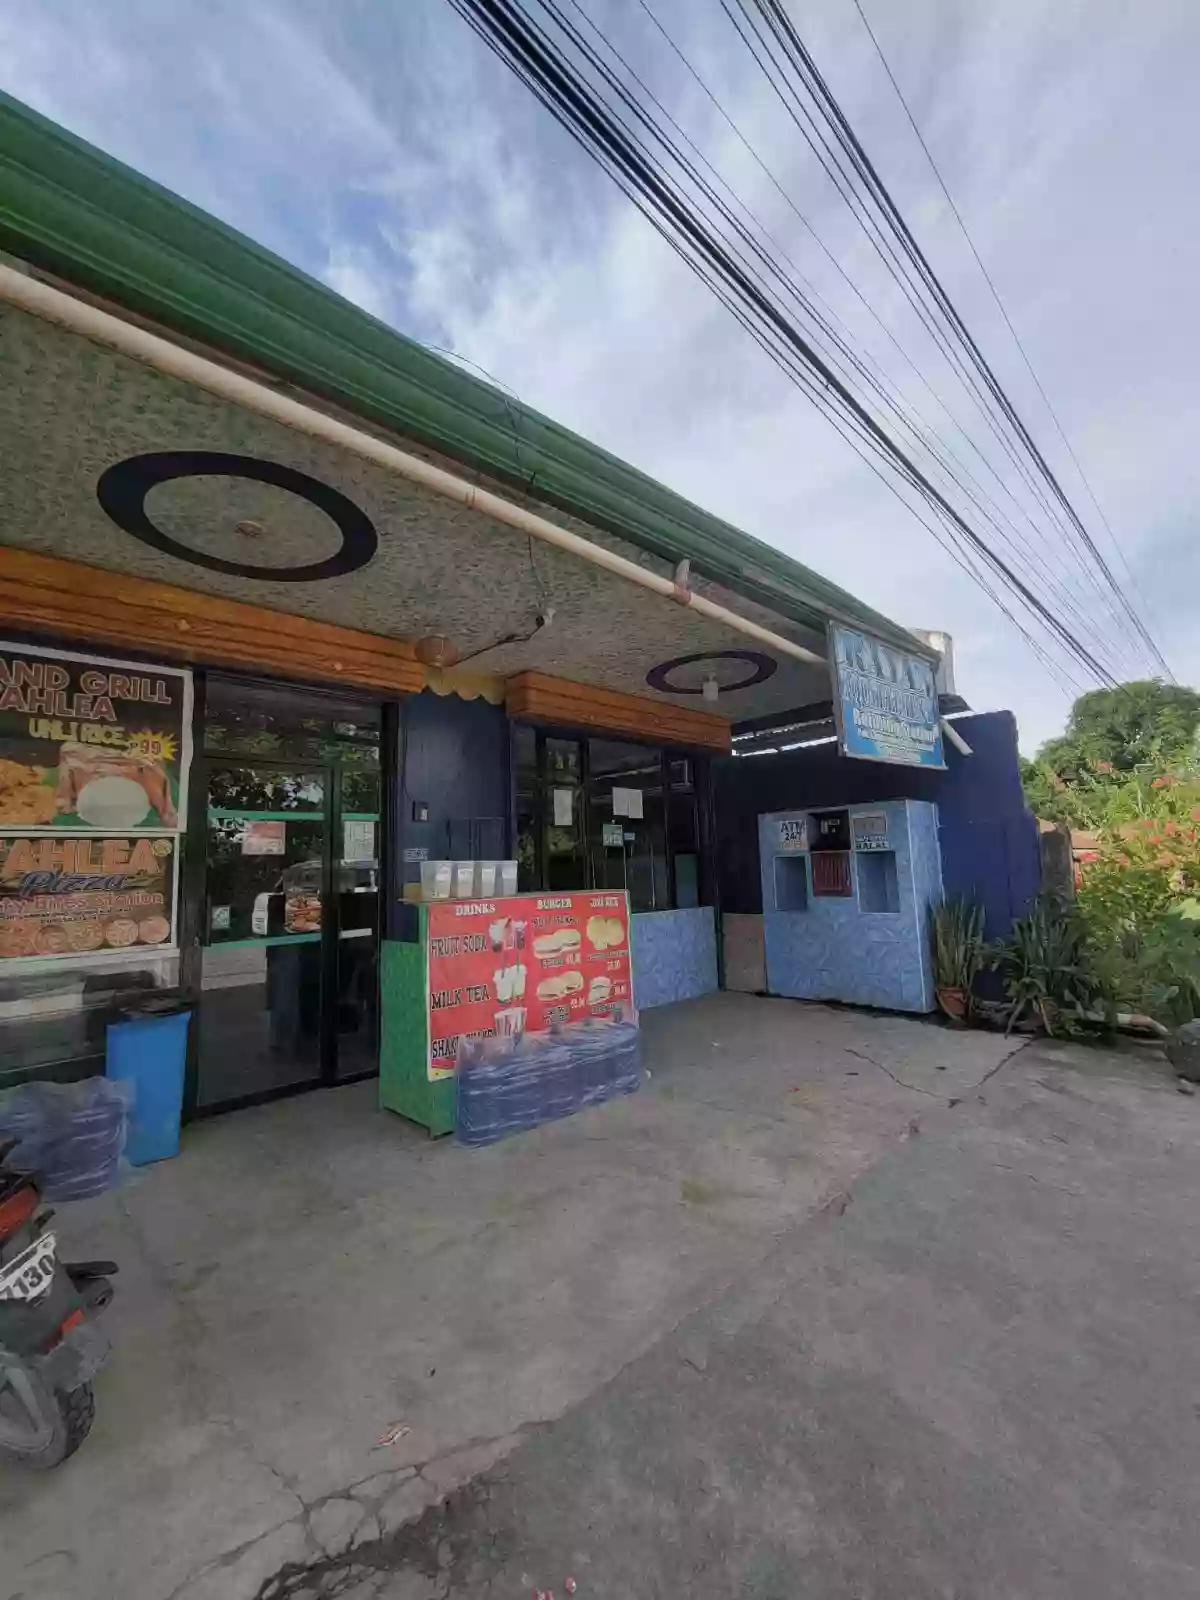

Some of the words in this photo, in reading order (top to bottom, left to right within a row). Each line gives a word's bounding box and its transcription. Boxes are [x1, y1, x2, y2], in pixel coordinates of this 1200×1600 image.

[80, 670, 172, 705] GRILL
[0, 685, 118, 722] AHLEA
[455, 903, 496, 917] DRINKS
[537, 897, 573, 910] BURGER
[431, 936, 460, 957] FRUIT
[463, 934, 487, 953] SODA
[431, 987, 463, 1010] MILK
[465, 985, 491, 1003] TEA
